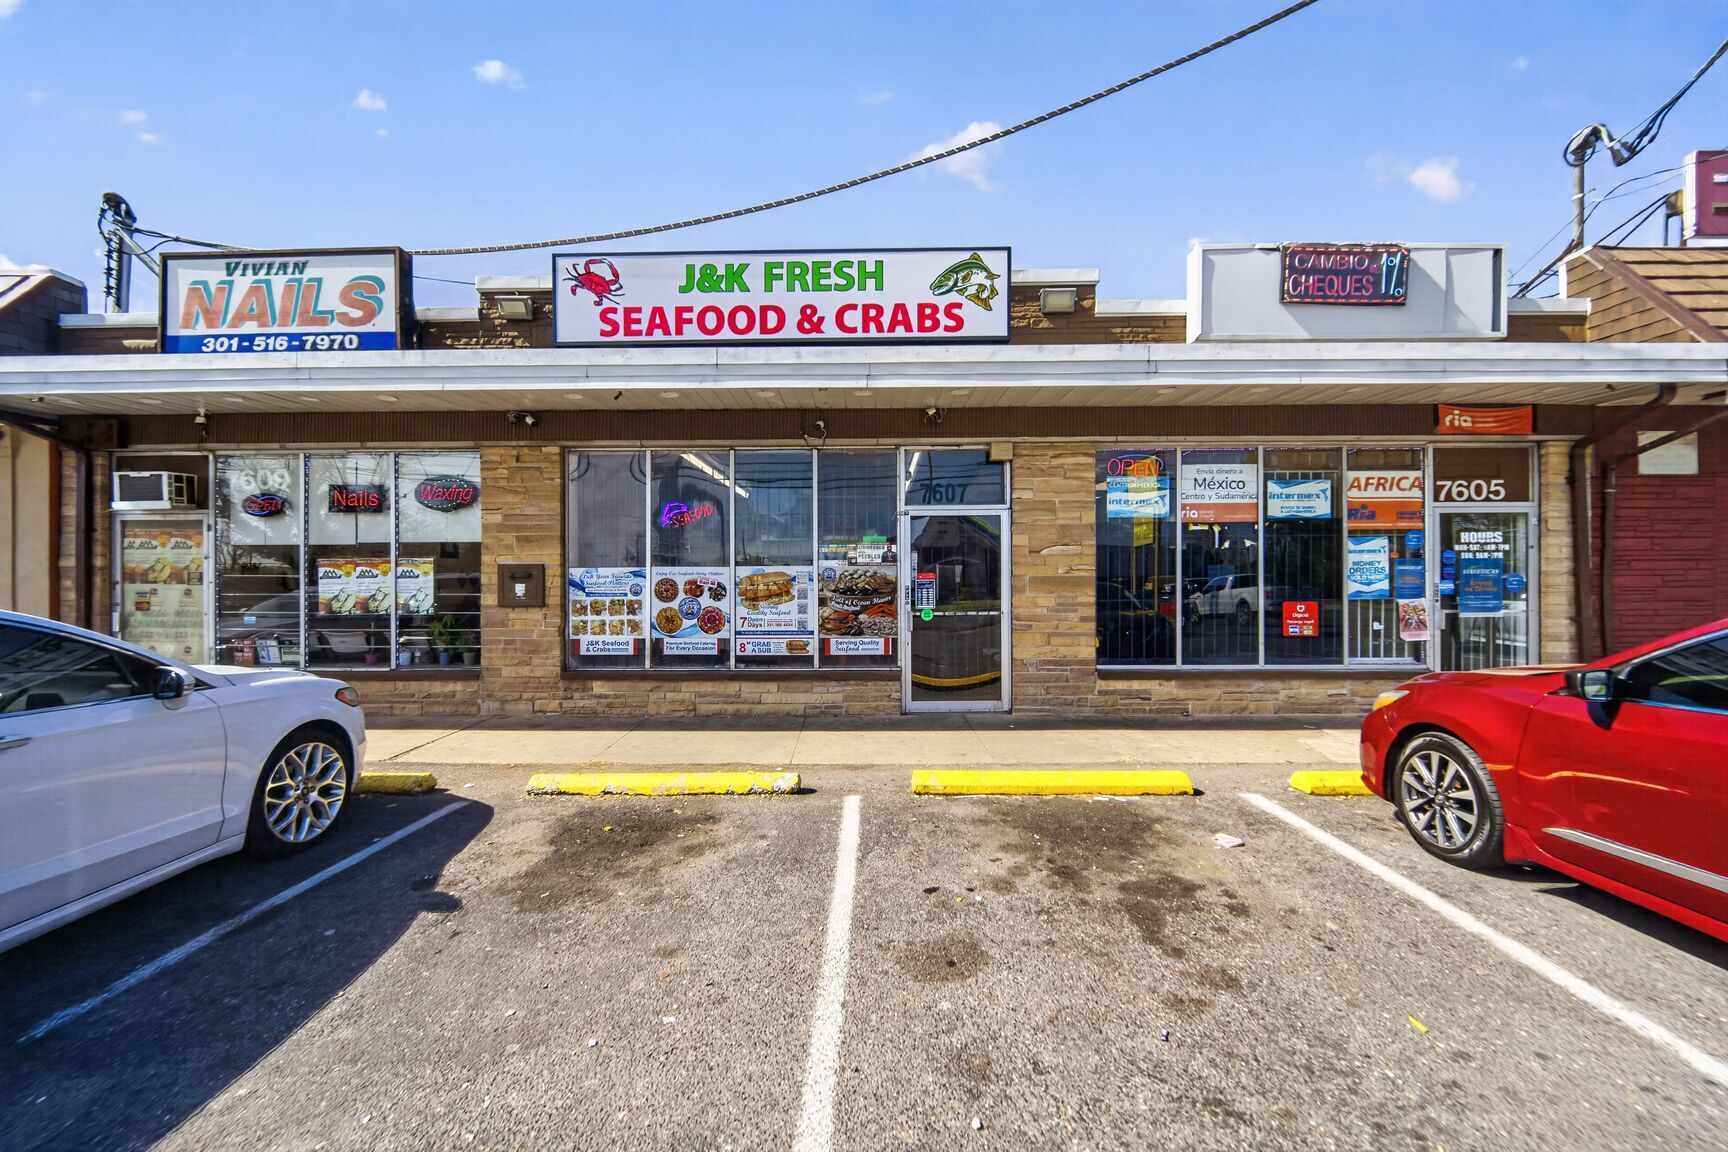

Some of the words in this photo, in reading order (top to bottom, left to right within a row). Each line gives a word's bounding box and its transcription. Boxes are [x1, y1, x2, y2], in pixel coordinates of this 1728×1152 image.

[225, 260, 309, 277] VIVIAN
[1295, 253, 1369, 270] CAMBIO
[678, 263, 751, 294] J&K
[763, 260, 885, 293] FRESH
[1288, 274, 1375, 297] CHEQUES
[179, 275, 387, 330] NAILS
[599, 305, 786, 338] SEAFOOD
[797, 304, 825, 336] &
[835, 302, 965, 335] CRABS
[201, 334, 359, 352] 301-516-7970
[1444, 409, 1473, 427] ria
[1107, 458, 1160, 477] OPEN
[1216, 467, 1238, 475] dinero
[1194, 476, 1246, 490] México
[1347, 476, 1422, 492] AFRICA
[1435, 479, 1506, 501] 7605
[333, 489, 379, 507] Nails
[420, 484, 473, 504] Waxing
[920, 483, 969, 504] 7607
[1181, 492, 1206, 500] Centro
[1214, 491, 1258, 500] Sudamérica
[1268, 491, 1321, 500] intermex
[1181, 506, 1199, 519] ria
[1347, 503, 1376, 521] Ria
[1460, 532, 1503, 543] HOURS
[1349, 567, 1386, 575] ORDERS
[740, 617, 747, 628] 7
[835, 645, 860, 653] Seafood
